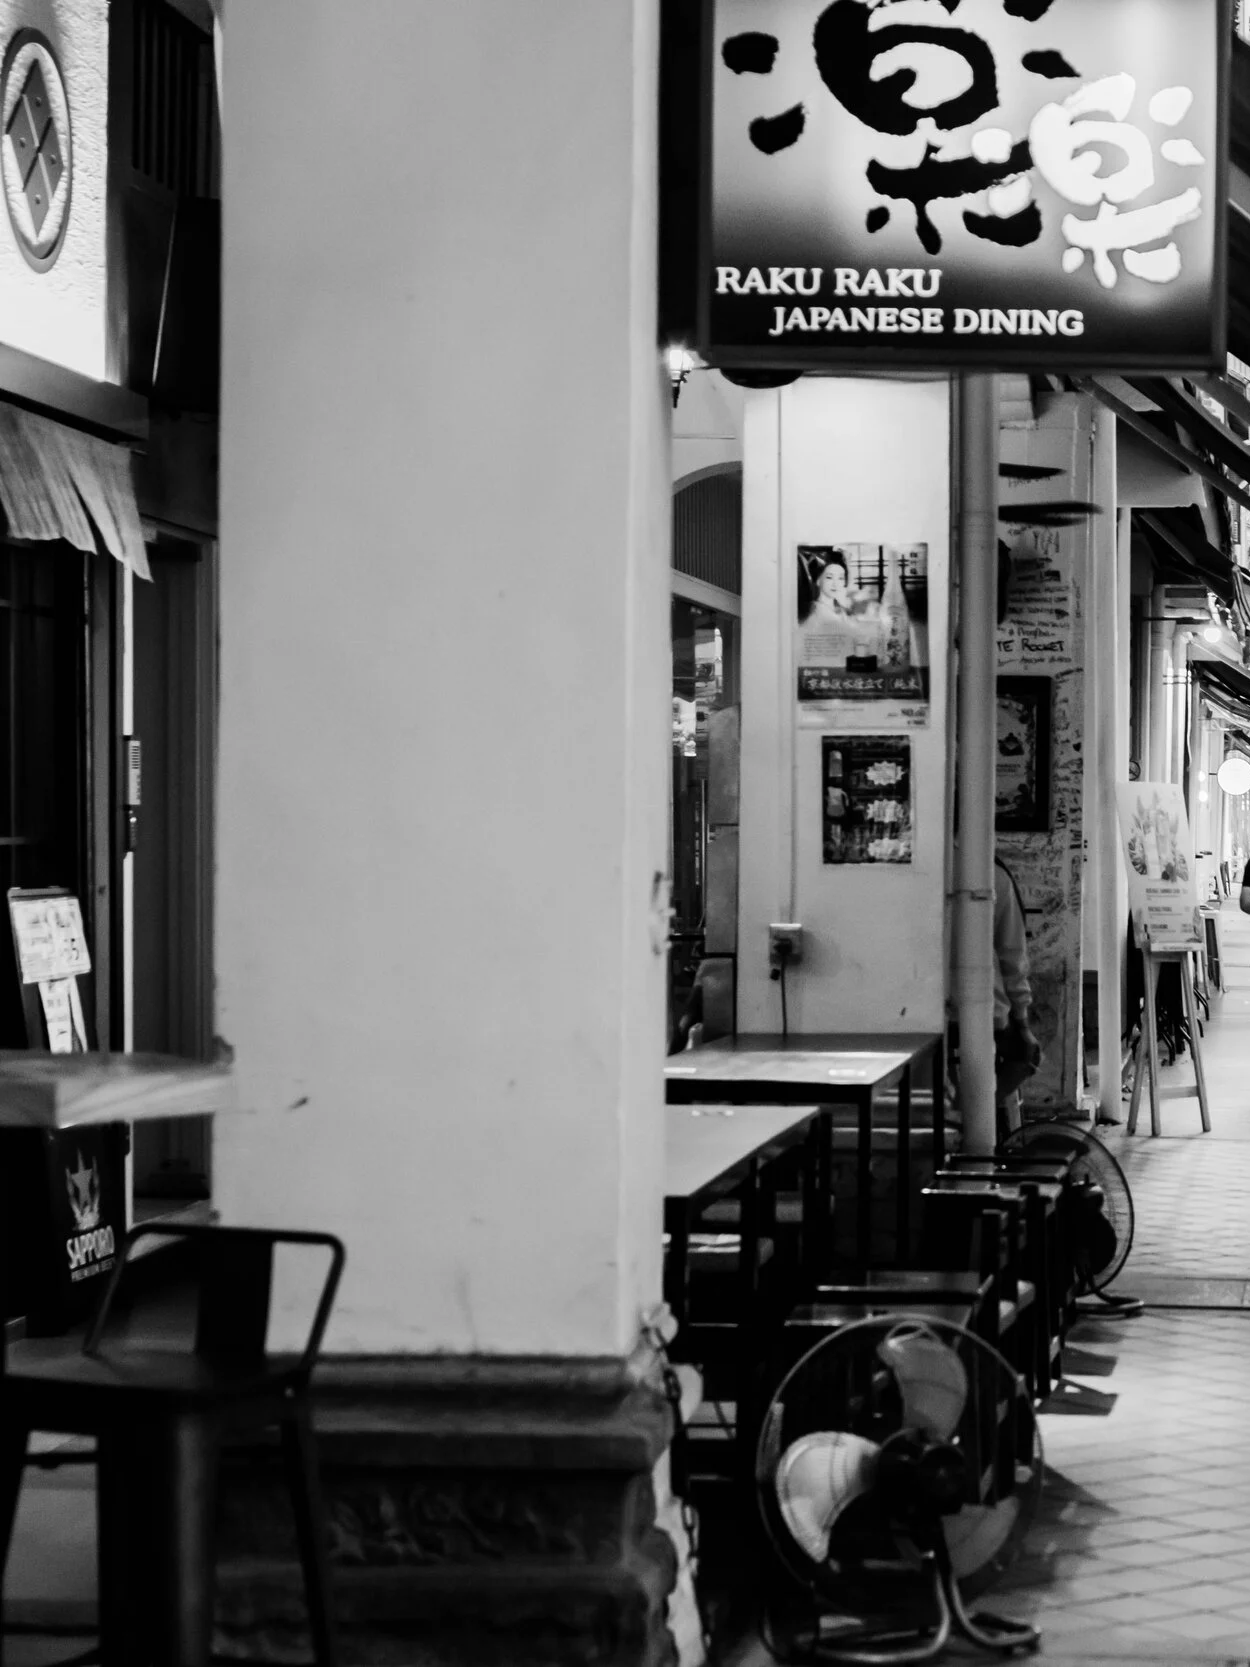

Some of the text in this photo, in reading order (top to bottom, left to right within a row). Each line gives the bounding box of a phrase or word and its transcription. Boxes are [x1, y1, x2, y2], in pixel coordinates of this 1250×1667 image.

[716, 267, 942, 297] RAKU RAKU
[769, 307, 1084, 336] JAPANESE DINING
[66, 1225, 115, 1269] SAPPORO
